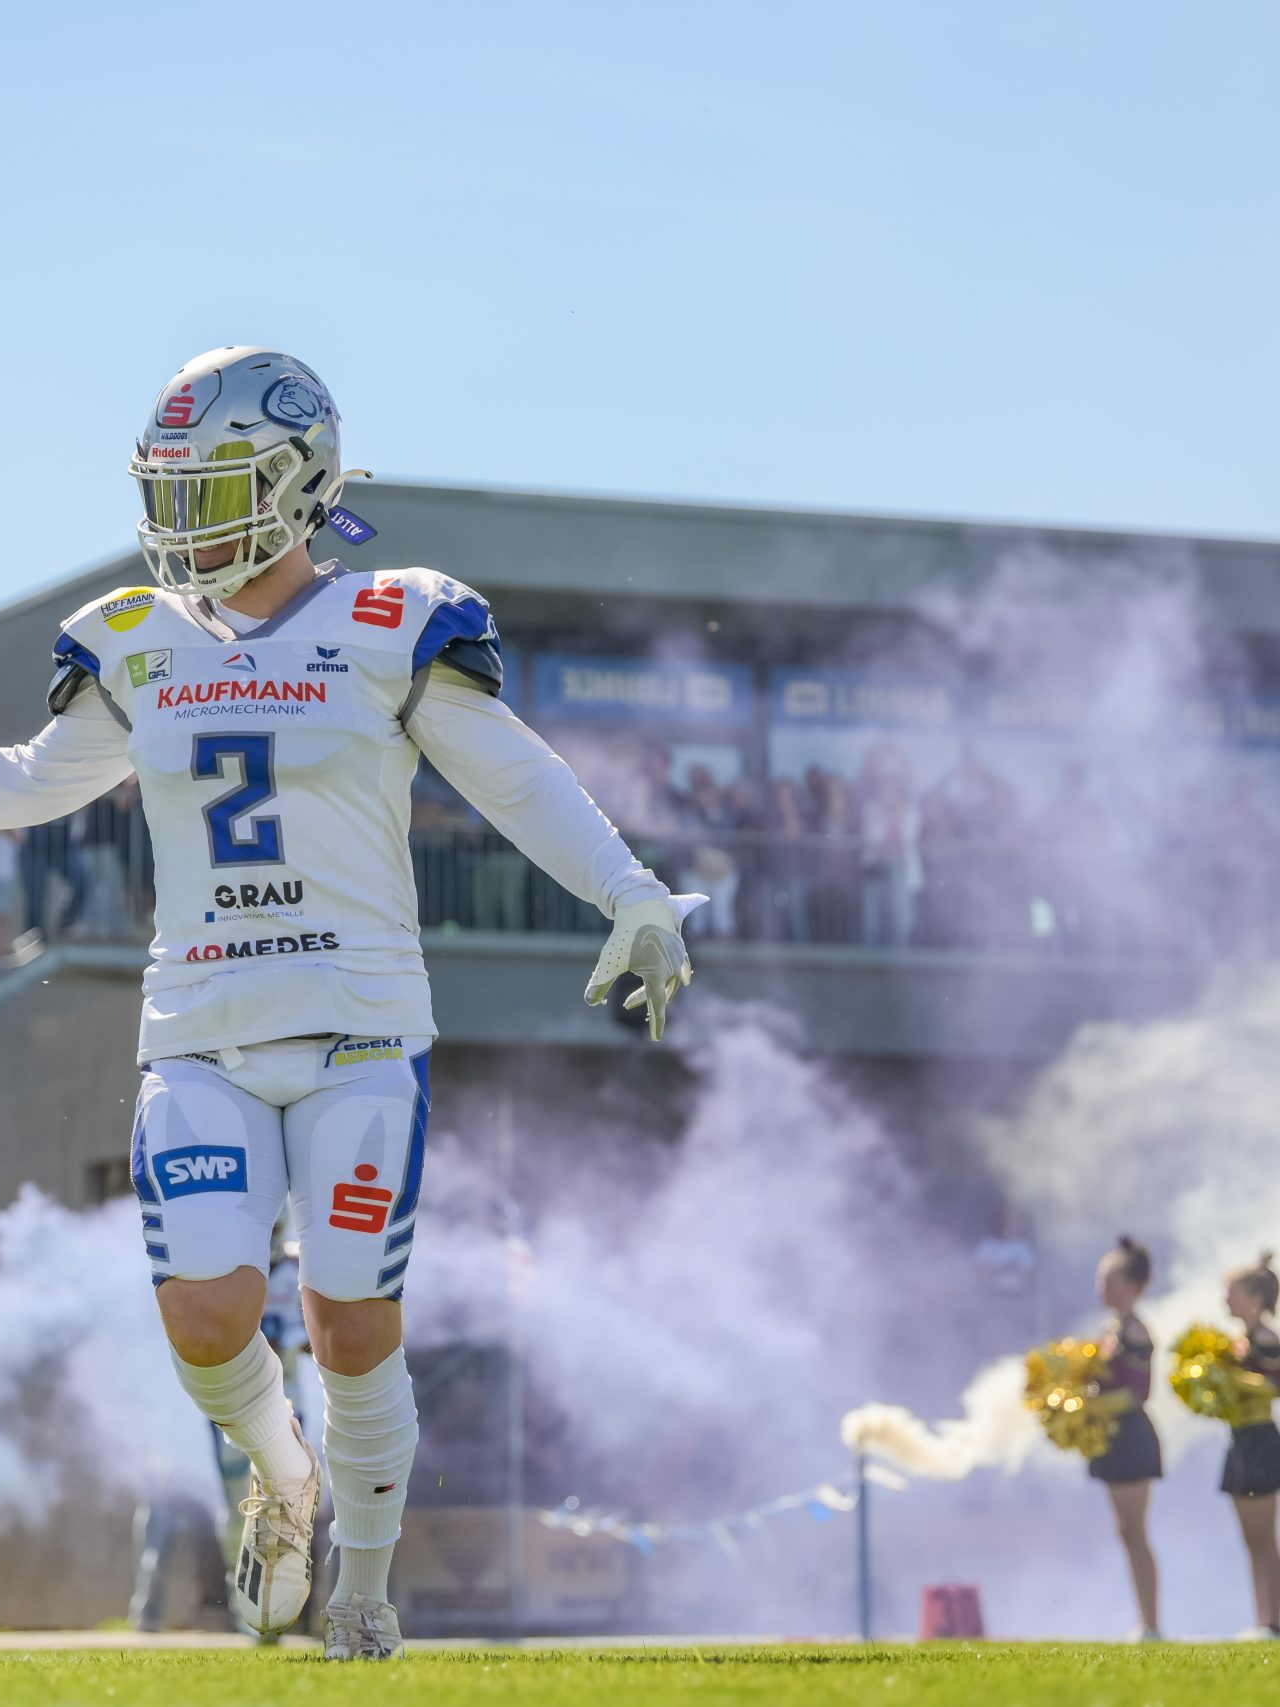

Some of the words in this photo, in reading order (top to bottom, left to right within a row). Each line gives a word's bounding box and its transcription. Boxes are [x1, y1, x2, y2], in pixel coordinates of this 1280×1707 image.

[152, 447, 190, 458] Riddell
[100, 593, 155, 613] HOFFMANN
[148, 670, 169, 680] GFL
[306, 662, 349, 673] erima
[157, 680, 327, 709] KAUFMANN
[174, 704, 307, 720] MICROMECHANIK
[190, 731, 286, 869] 2
[217, 912, 265, 923] INNOVATIVE
[267, 909, 305, 919] METALLE
[164, 1156, 238, 1185] SWP
